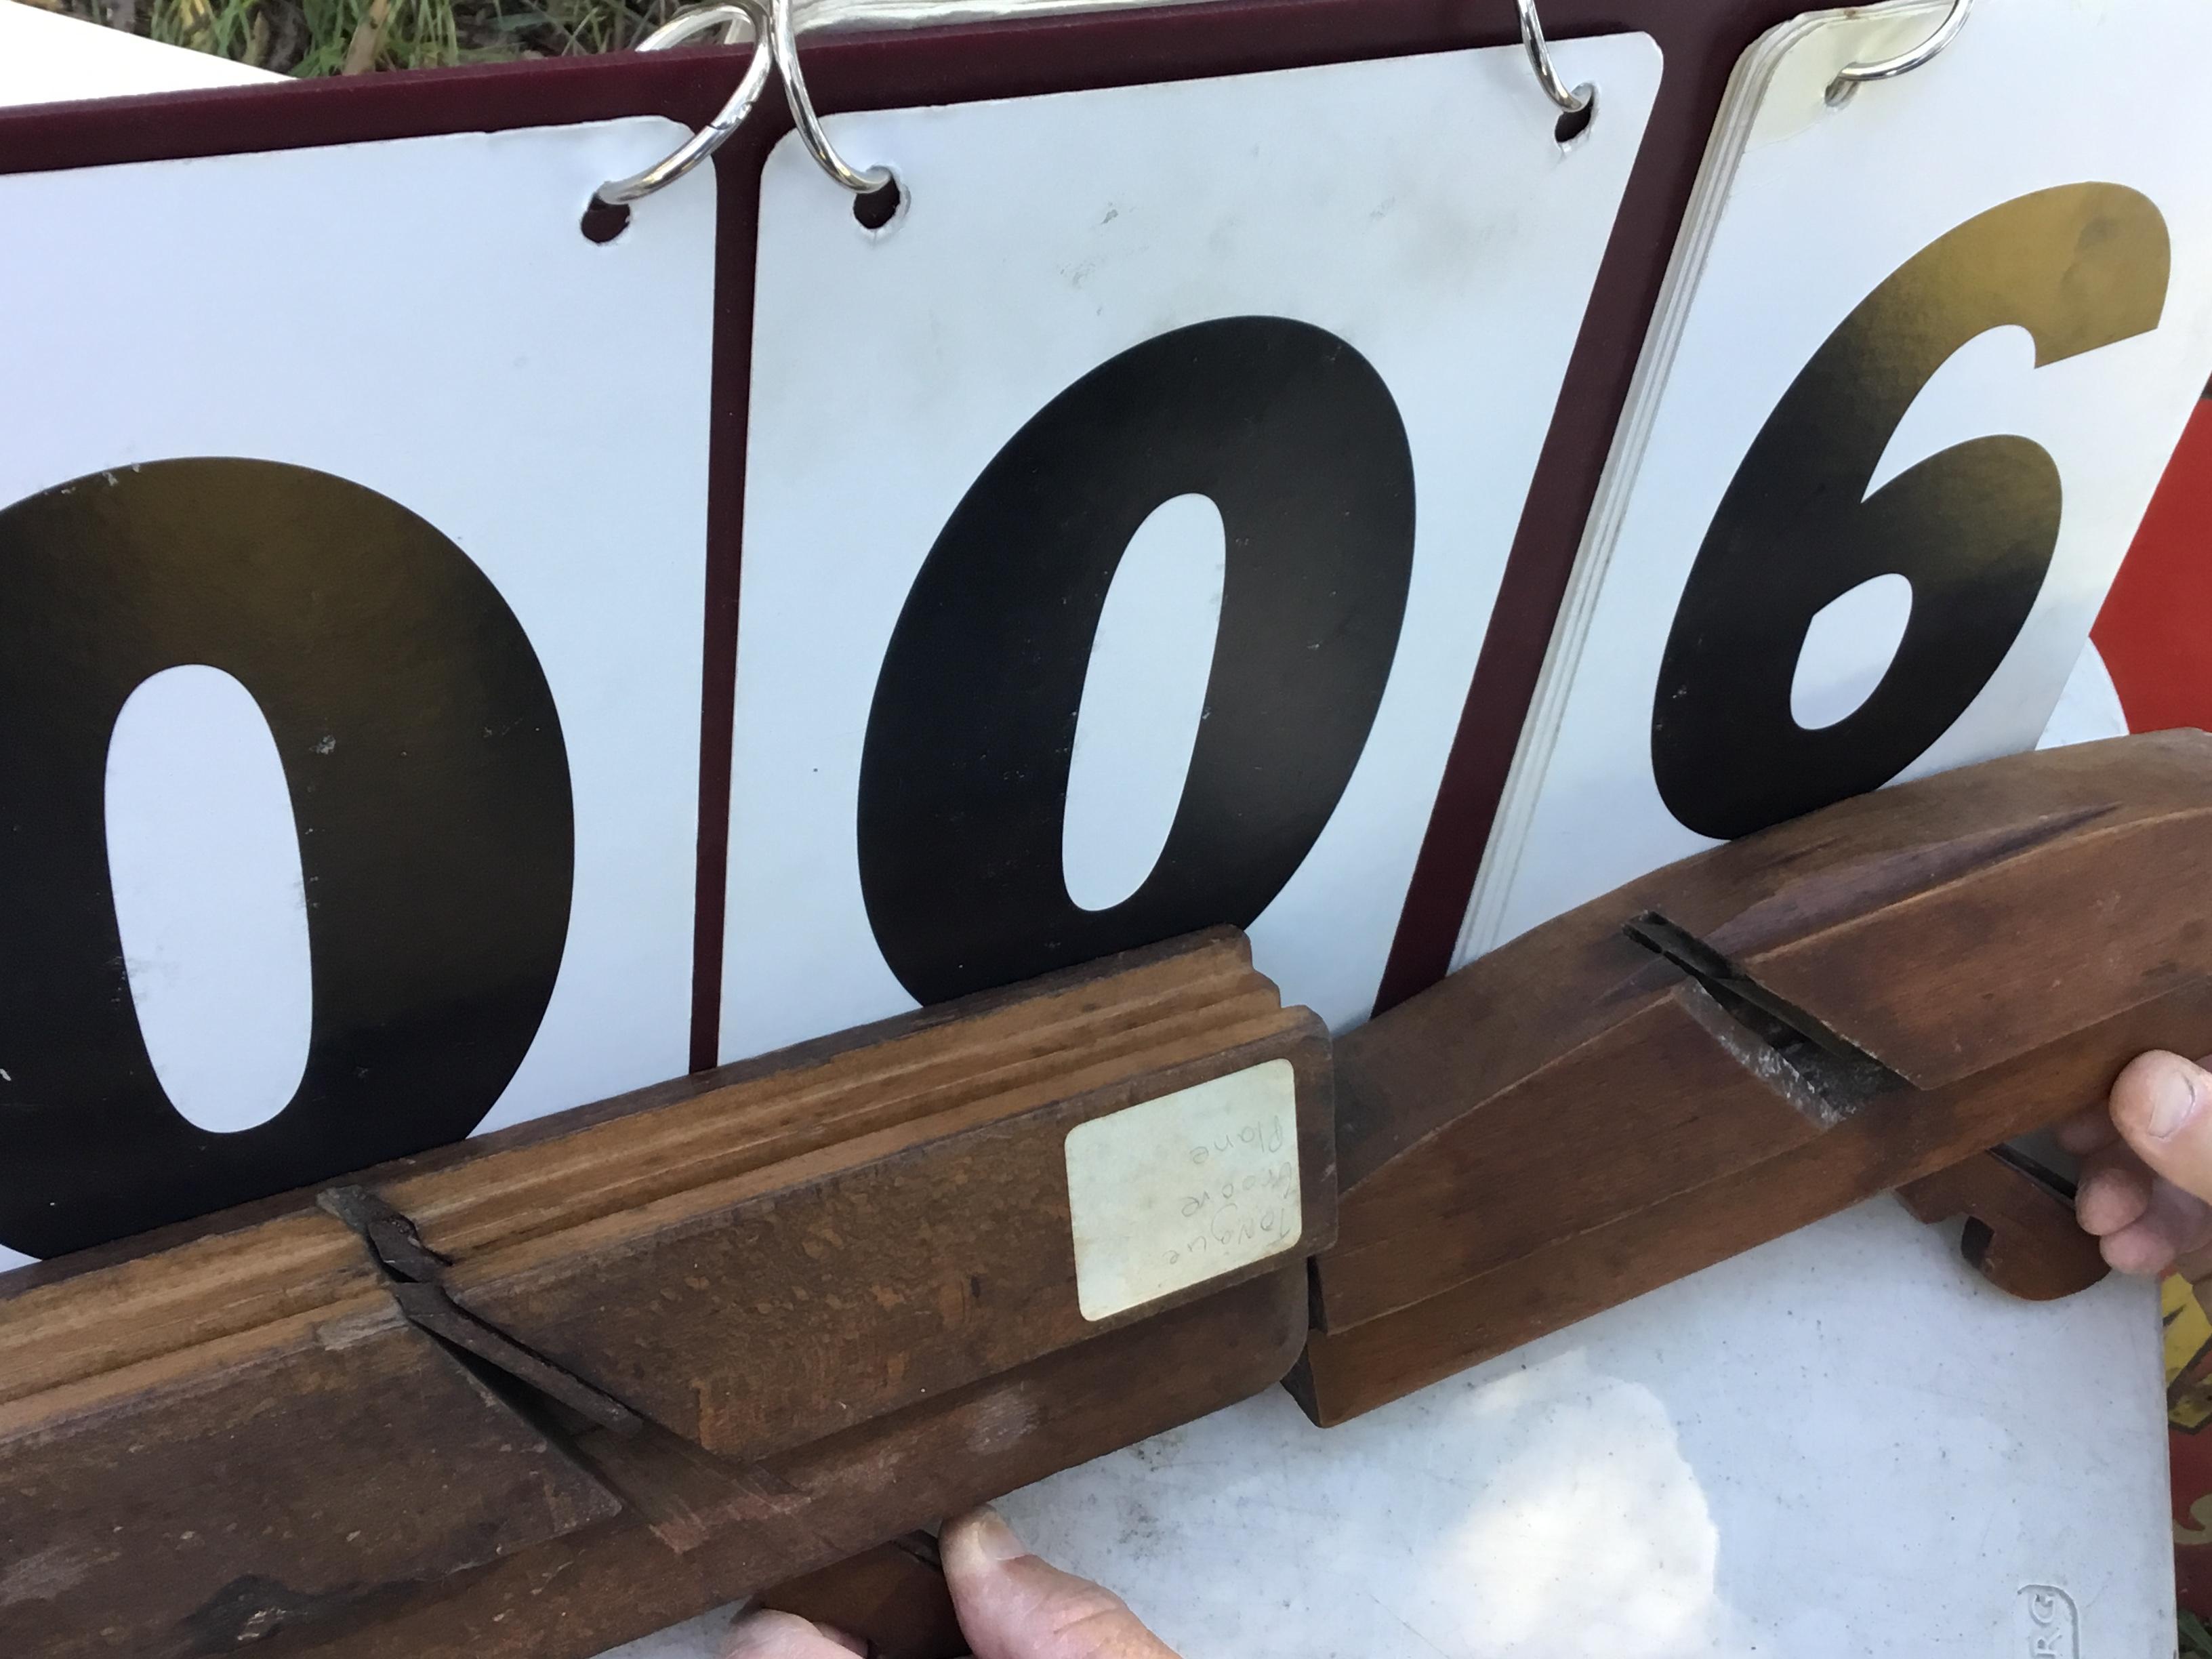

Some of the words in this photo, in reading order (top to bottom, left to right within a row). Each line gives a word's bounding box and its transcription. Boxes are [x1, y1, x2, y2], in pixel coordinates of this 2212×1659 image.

[1653, 182, 2170, 840] 6
[1190, 1115, 1283, 1165] Plane
[1179, 1162, 1292, 1218] Groove
